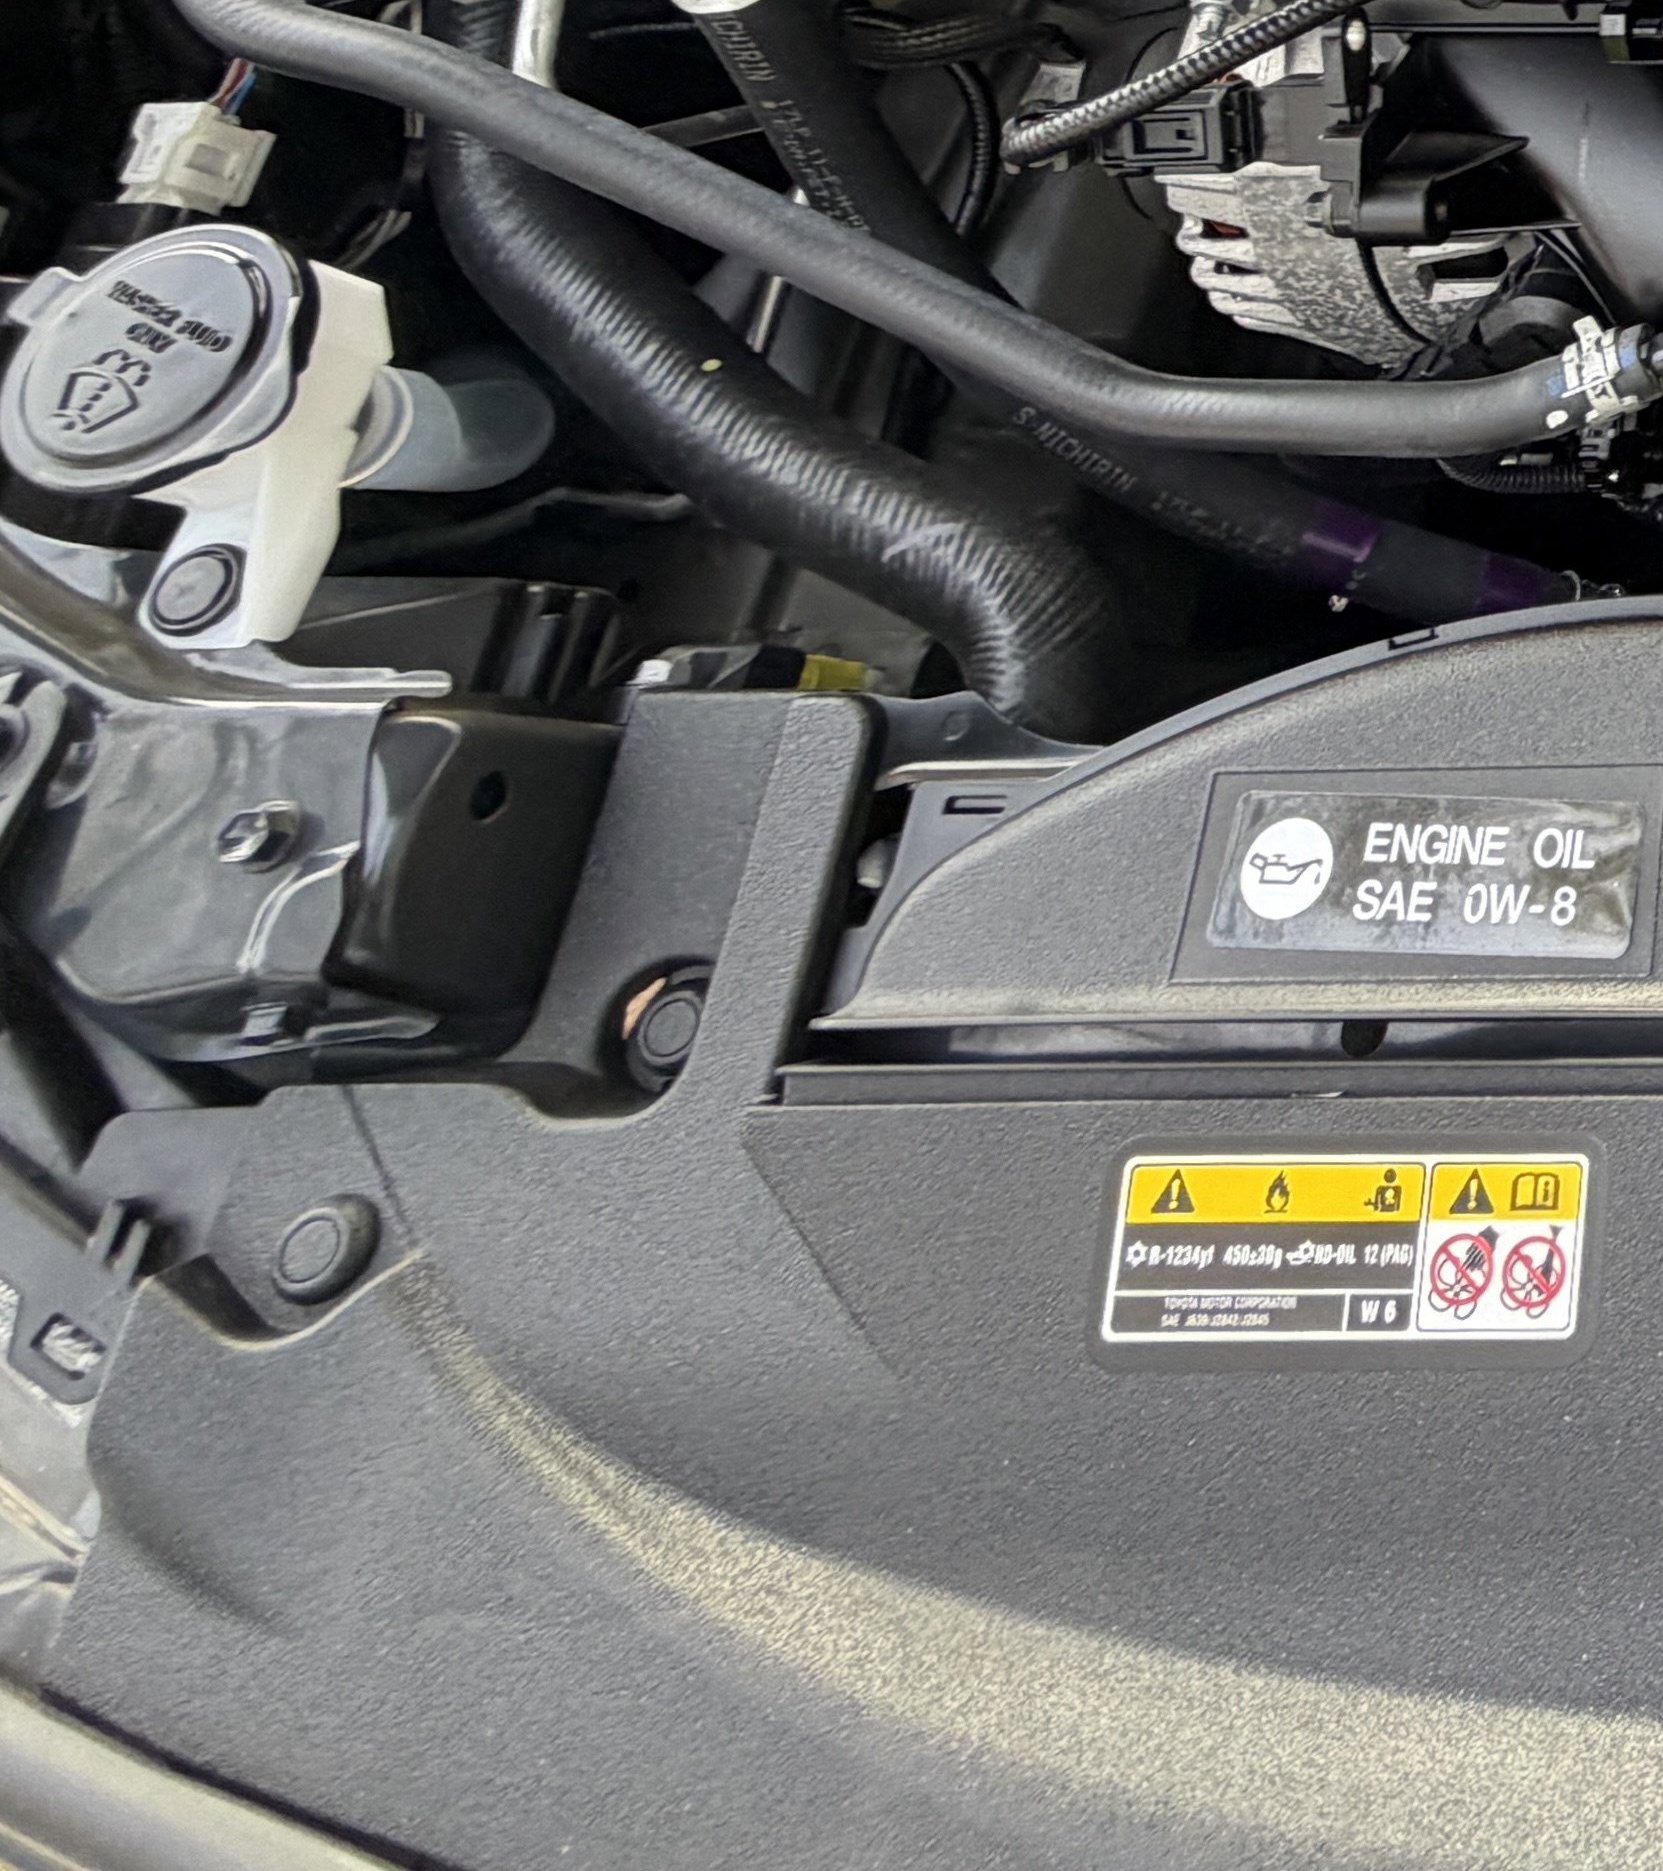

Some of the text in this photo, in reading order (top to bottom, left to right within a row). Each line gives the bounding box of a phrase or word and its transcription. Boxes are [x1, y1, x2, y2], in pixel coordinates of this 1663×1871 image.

[1362, 821, 1597, 870] ENGINE OIL
[1351, 879, 1578, 927] SAE 0W-8
[1222, 1244, 1284, 1272] 450±30g
[1164, 1296, 1297, 1310] TOYOTA MOTOR CORPORATION
[1360, 1299, 1397, 1324] W 6
[1160, 1313, 1182, 1327] SAE
